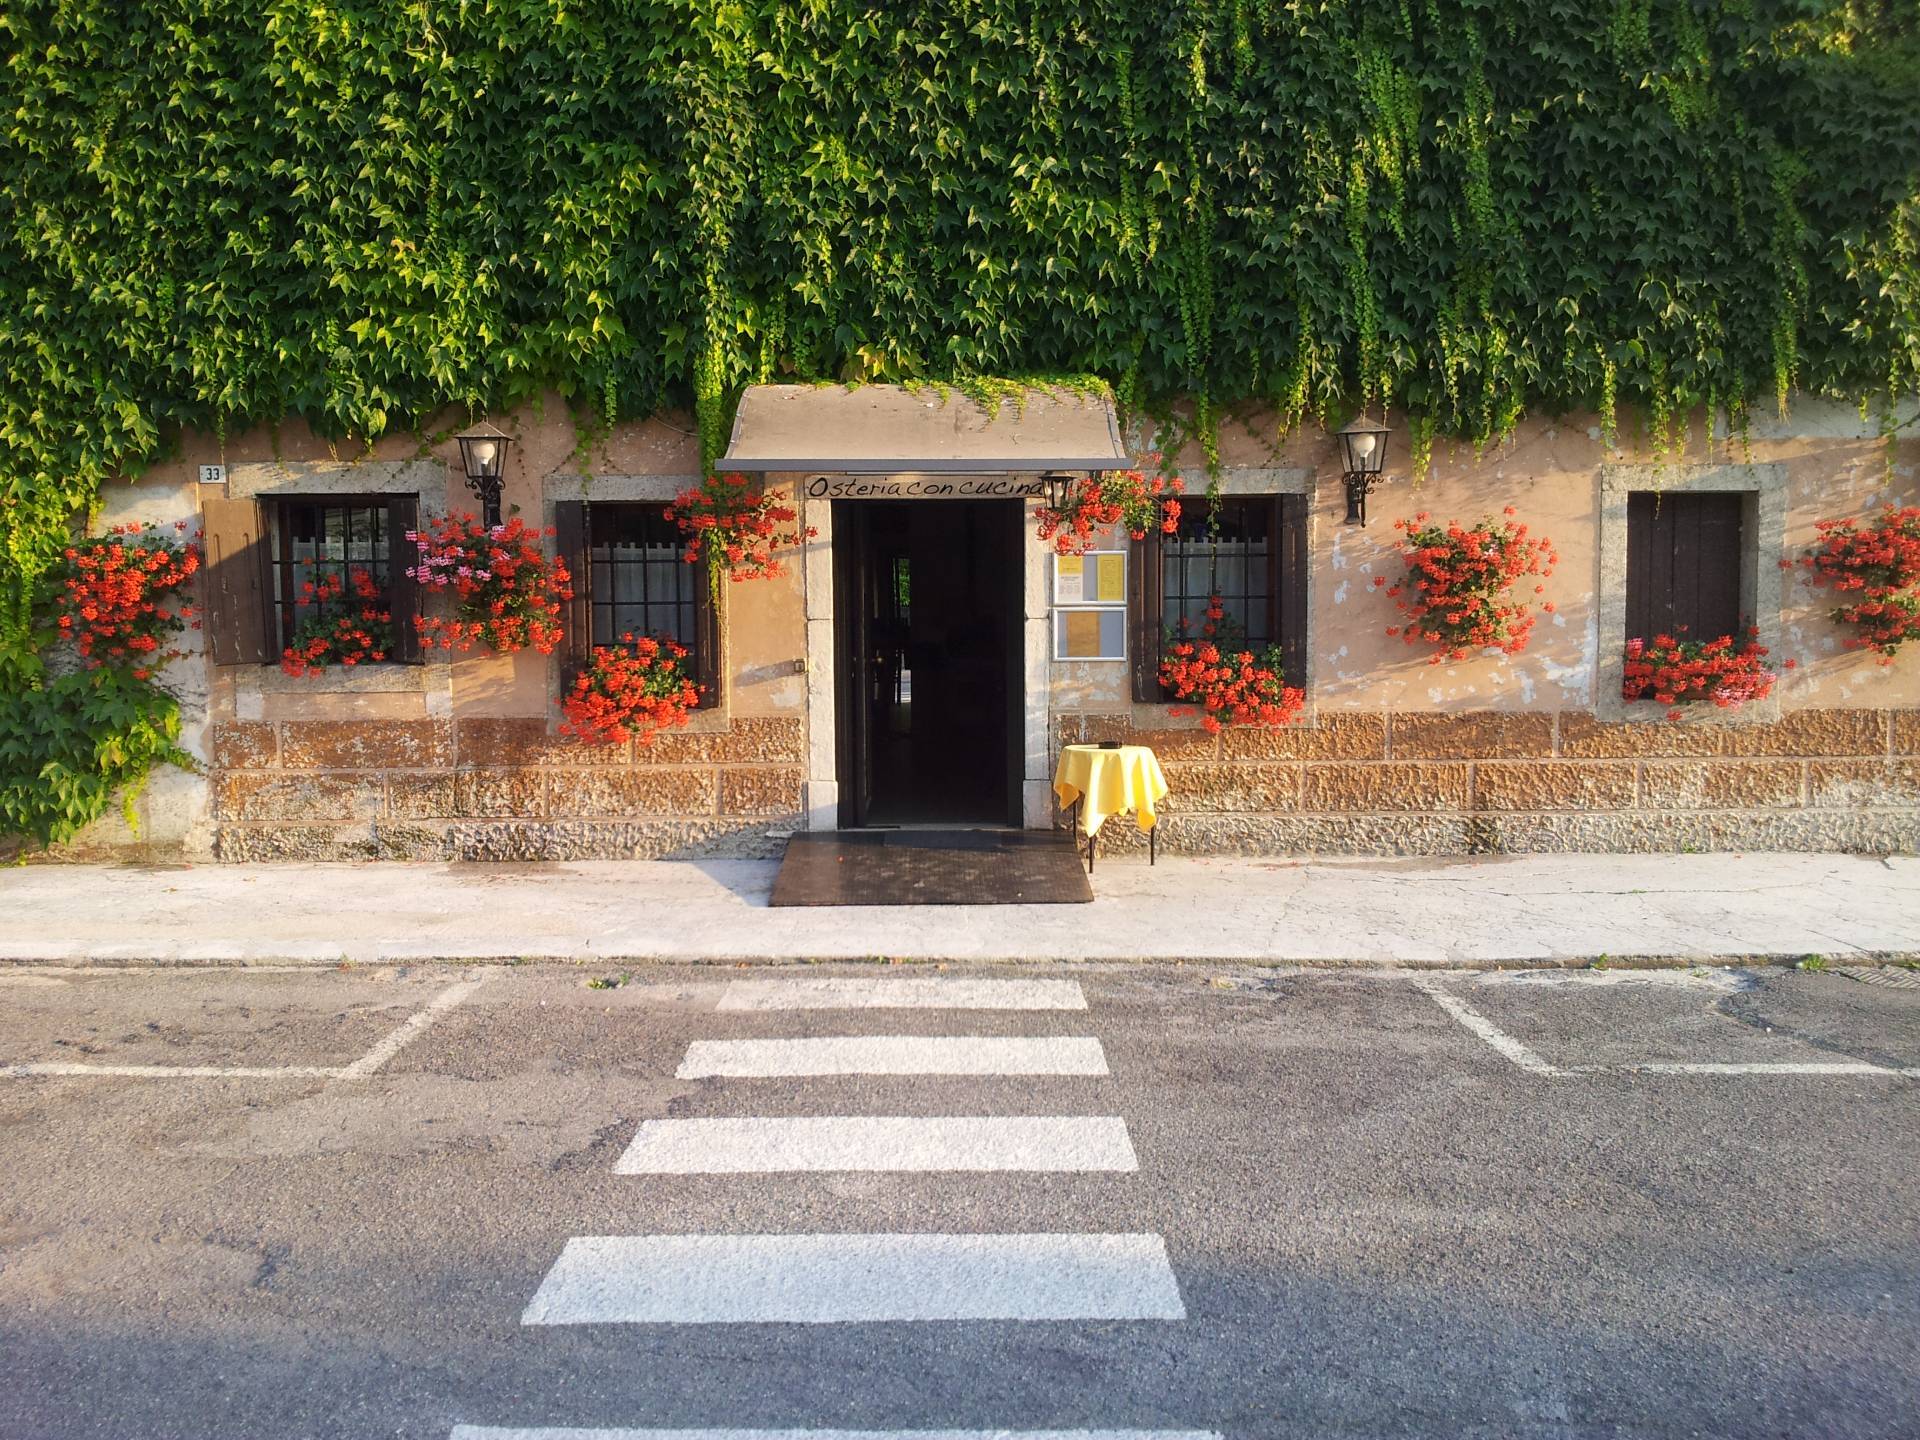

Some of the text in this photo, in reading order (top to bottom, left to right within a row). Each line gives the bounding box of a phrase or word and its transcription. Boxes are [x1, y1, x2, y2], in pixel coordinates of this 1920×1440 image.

[206, 467, 219, 480] 33
[809, 476, 1042, 497] Osteria con cucina
